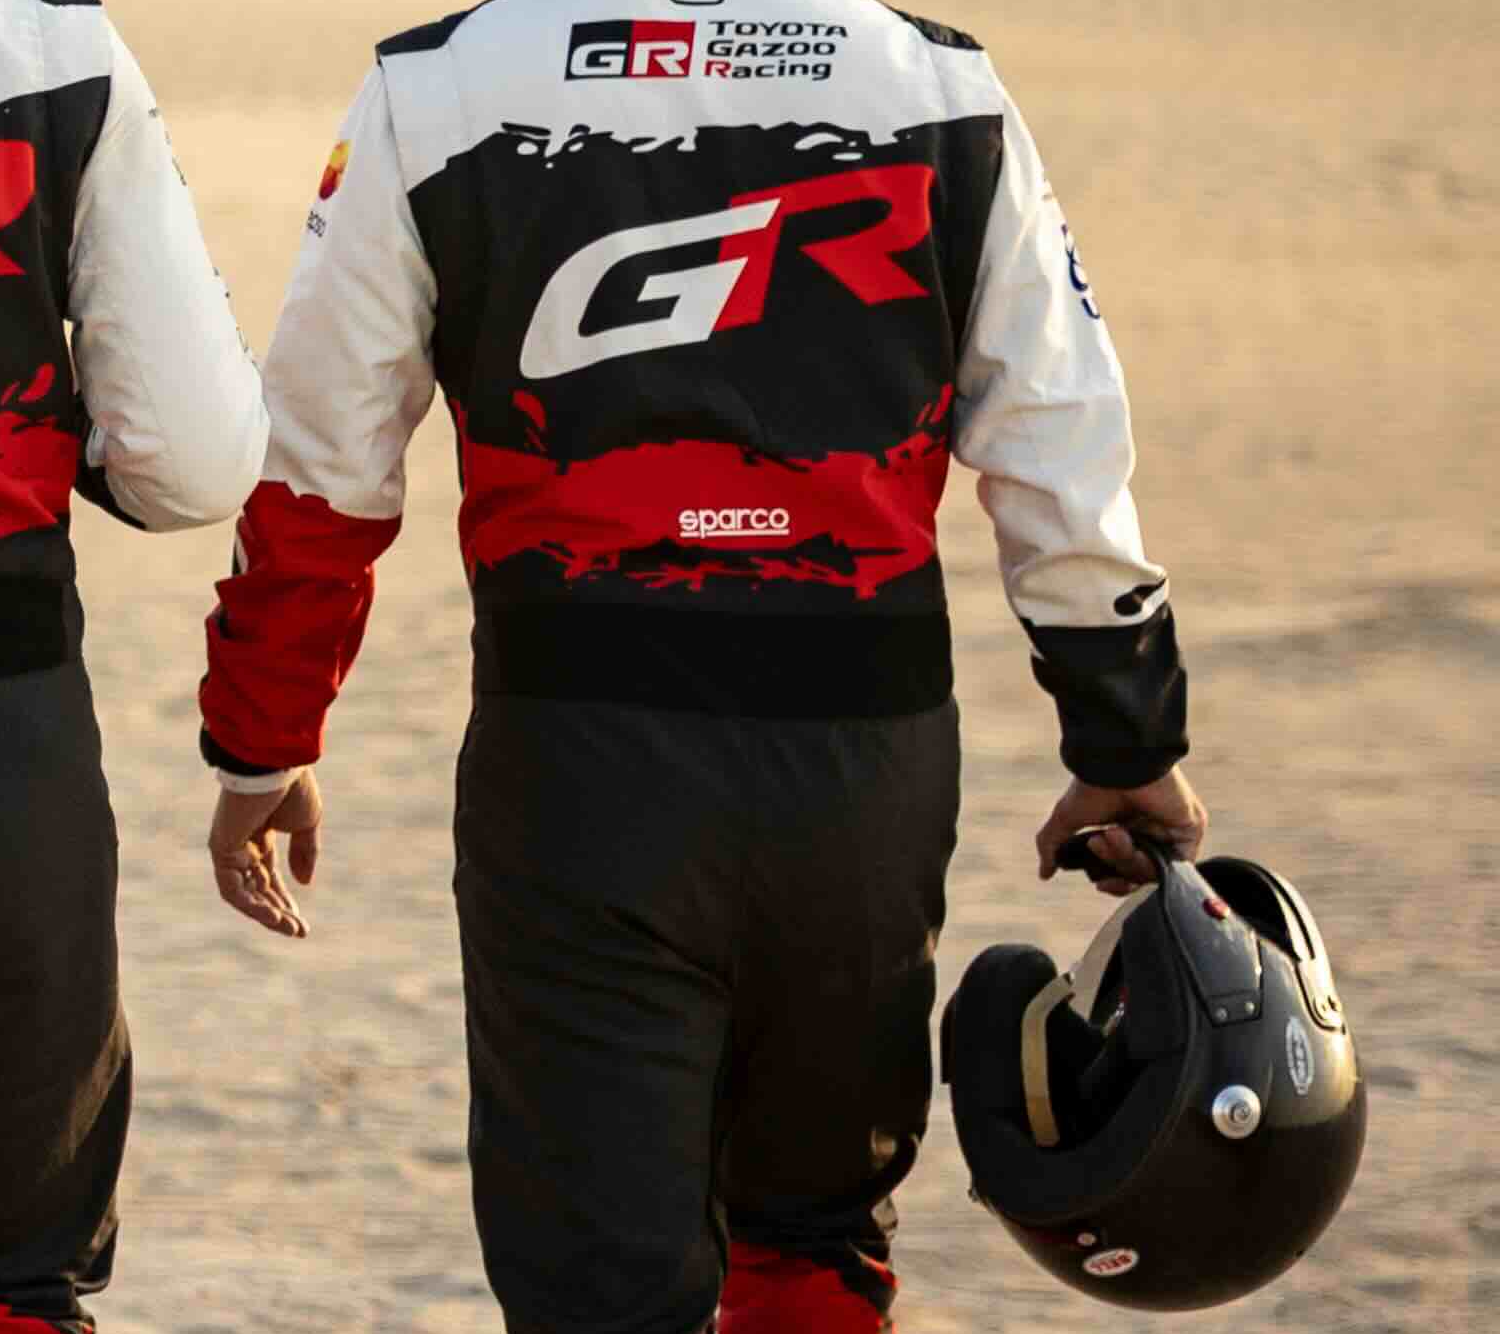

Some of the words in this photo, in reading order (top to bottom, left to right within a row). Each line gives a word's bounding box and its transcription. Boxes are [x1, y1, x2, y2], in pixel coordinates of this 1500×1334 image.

[708, 21, 848, 38] TOYOTA
[570, 41, 689, 76] GR
[707, 39, 836, 57] GAZOO
[704, 60, 832, 80] Racing
[520, 163, 936, 380] GR
[679, 508, 790, 539] sparco
